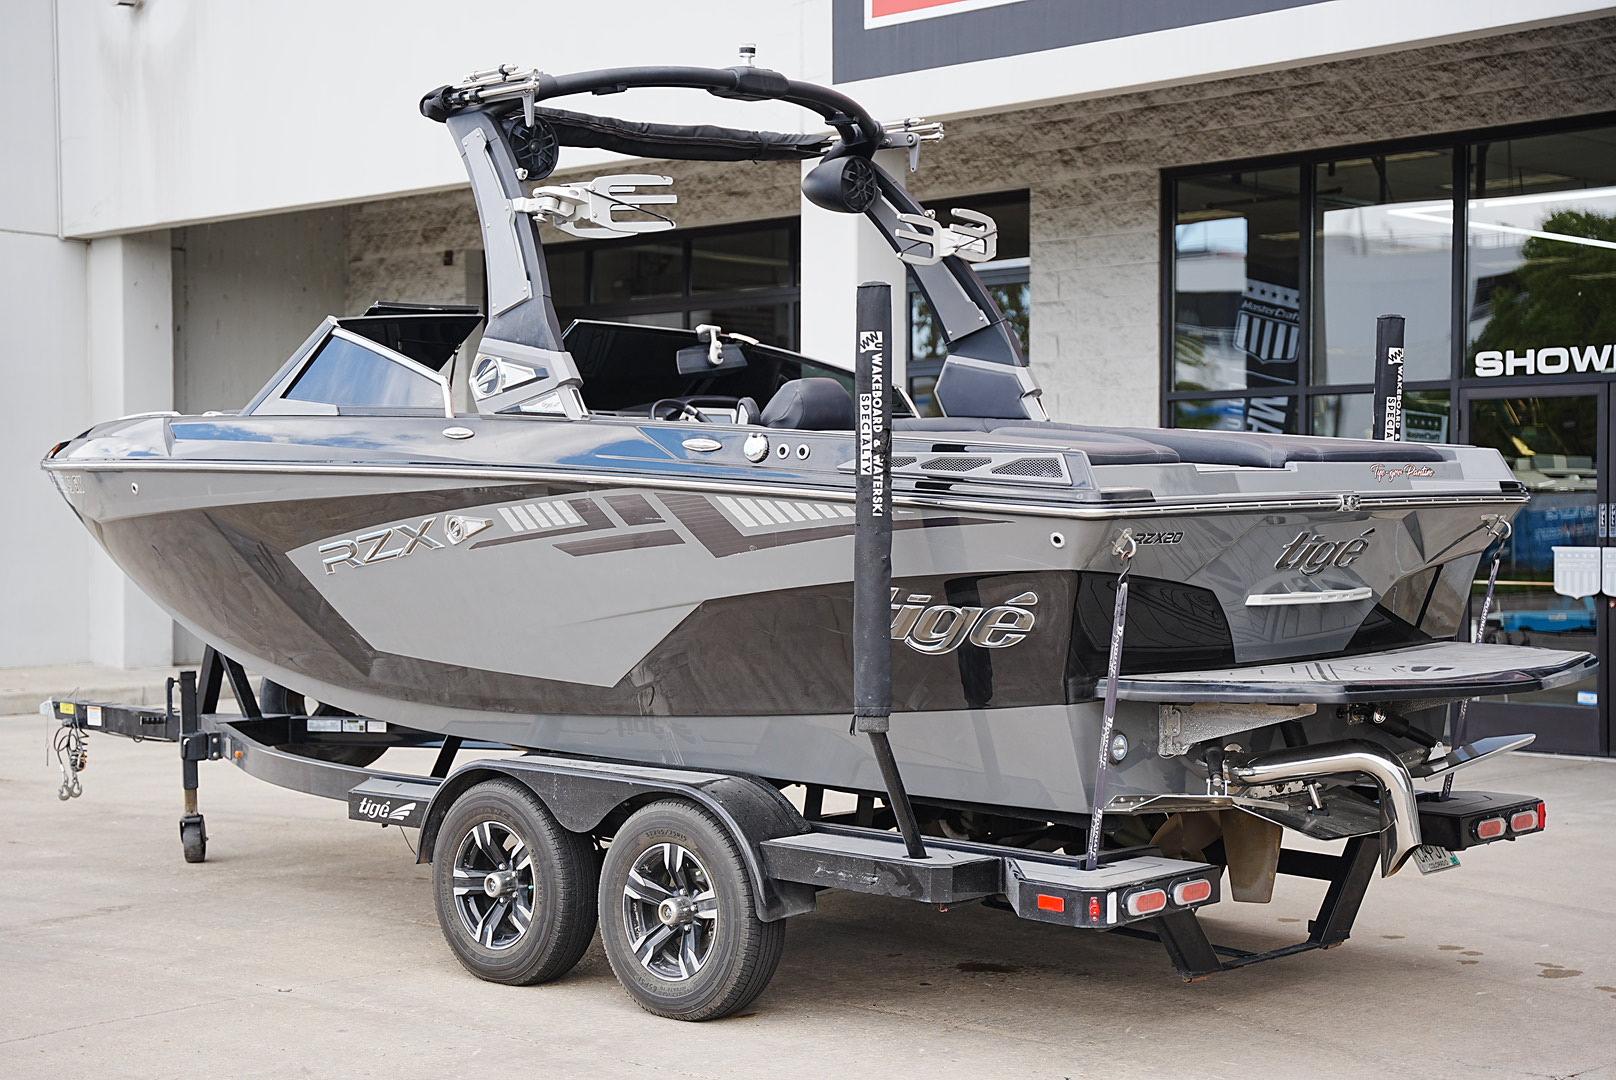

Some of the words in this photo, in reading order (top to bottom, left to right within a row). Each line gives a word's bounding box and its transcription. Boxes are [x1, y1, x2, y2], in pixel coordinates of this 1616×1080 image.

[1475, 344, 1616, 377] SHOW
[871, 353, 883, 433] WAKEBOARD
[861, 396, 871, 473] SPECIALTY
[872, 454, 884, 517] WATERSKI
[318, 516, 445, 575] RZX
[1134, 531, 1184, 545] RZX20
[1273, 527, 1375, 576] tigé
[359, 797, 391, 819] tigé
